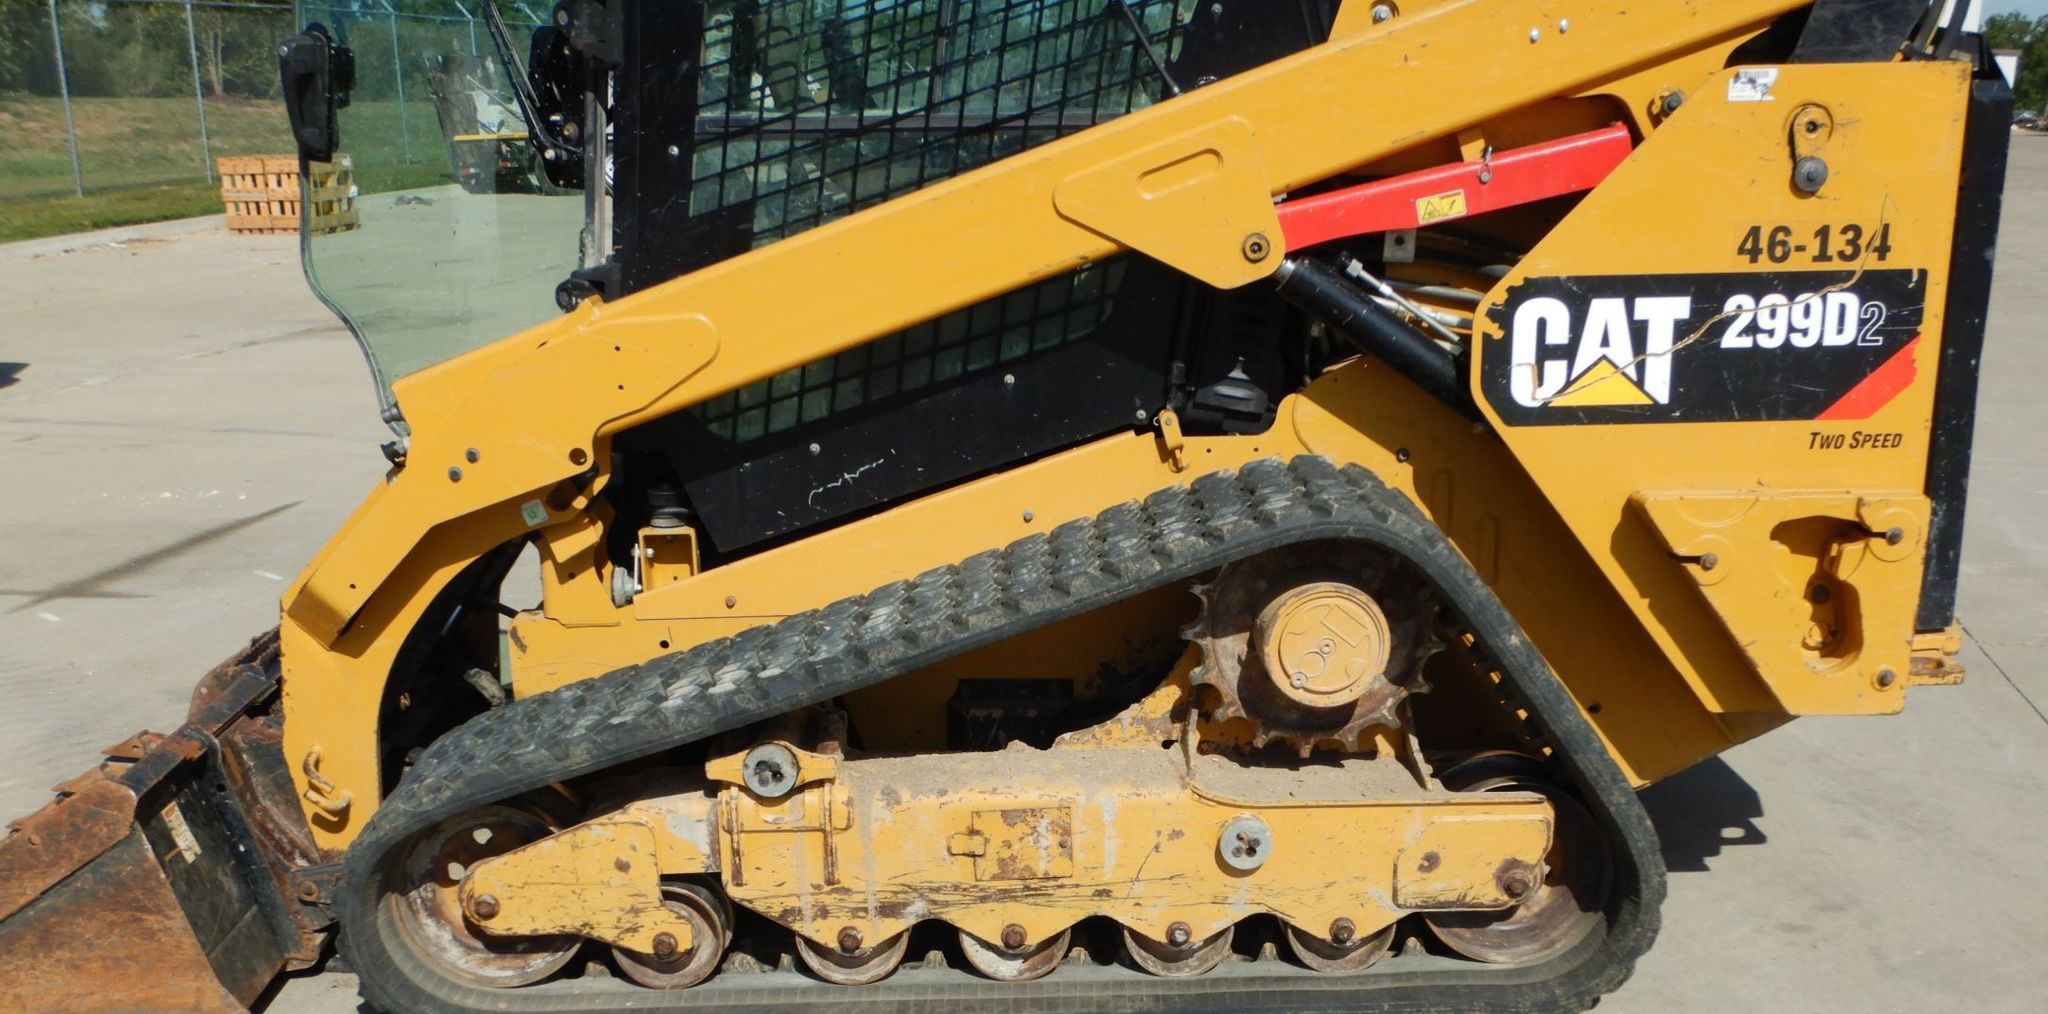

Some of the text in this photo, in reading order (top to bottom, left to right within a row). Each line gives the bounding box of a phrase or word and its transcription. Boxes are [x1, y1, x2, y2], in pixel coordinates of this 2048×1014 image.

[1737, 223, 1892, 264] 46-134
[1510, 291, 1887, 409] CAT 299D2
